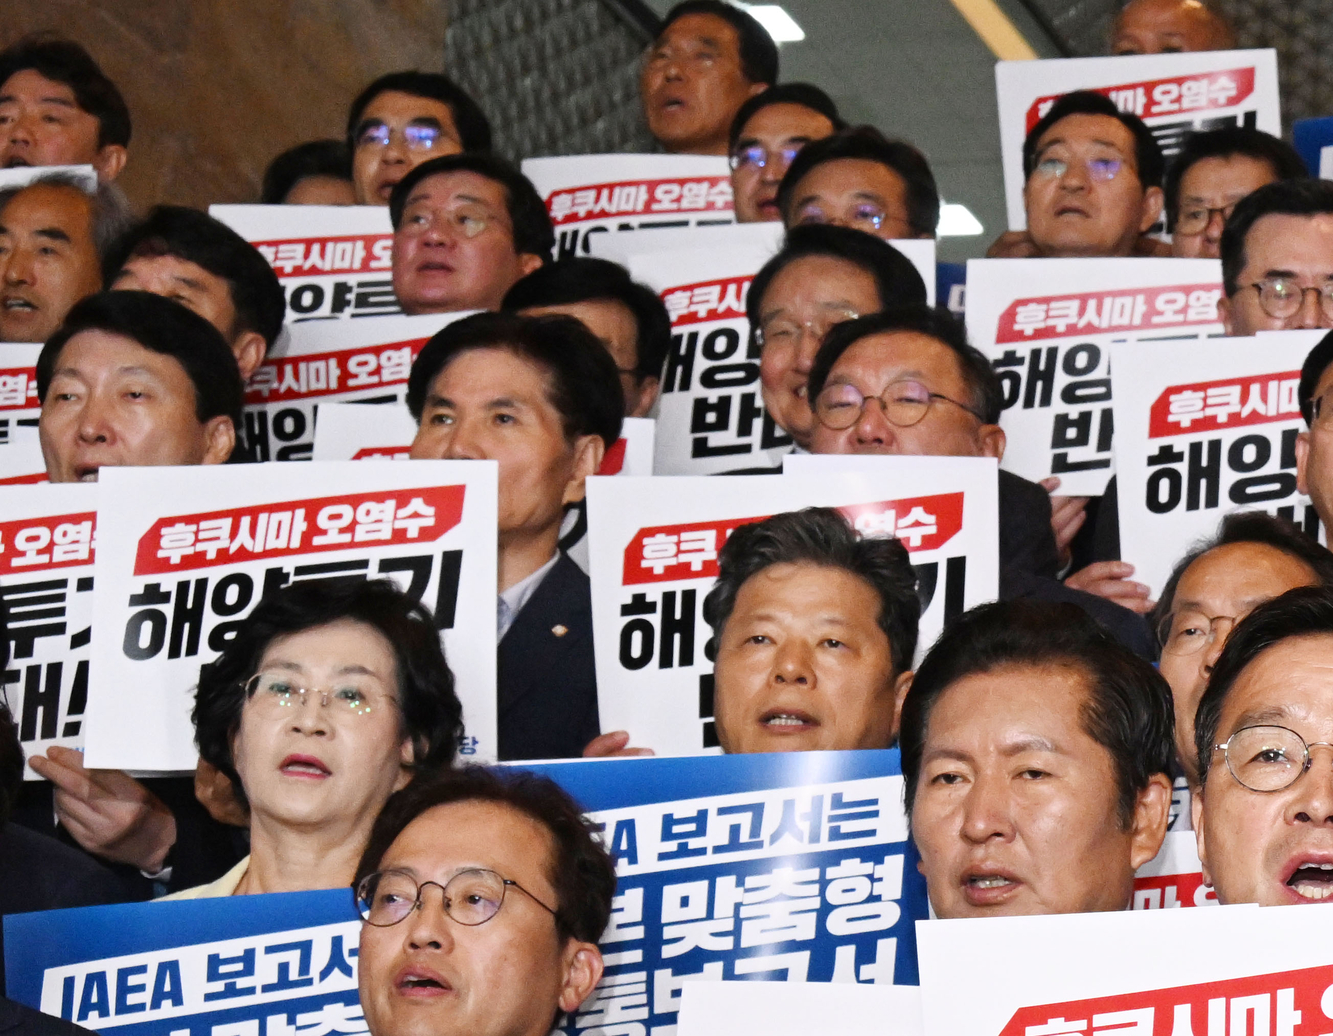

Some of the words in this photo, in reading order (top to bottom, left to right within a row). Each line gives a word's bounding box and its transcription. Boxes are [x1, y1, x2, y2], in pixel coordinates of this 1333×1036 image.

[1151, 76, 1238, 113] 오염수
[550, 185, 649, 221] 후쿠시마
[664, 281, 748, 322] 후쿠시
[1013, 293, 1147, 336] 후쿠시마
[1151, 288, 1223, 325] 오염
[247, 358, 340, 397] 쿠시마
[347, 346, 416, 383] 오염
[992, 342, 1113, 411] 해양
[1146, 428, 1299, 515] 해양
[10, 520, 95, 567] 오염
[156, 507, 306, 564] 후쿠시마
[312, 497, 436, 547] 오염수
[640, 527, 723, 575] 후쿠
[656, 791, 880, 863] 보고서는
[660, 853, 906, 960] 맞춤형
[60, 958, 184, 1023] IAEA
